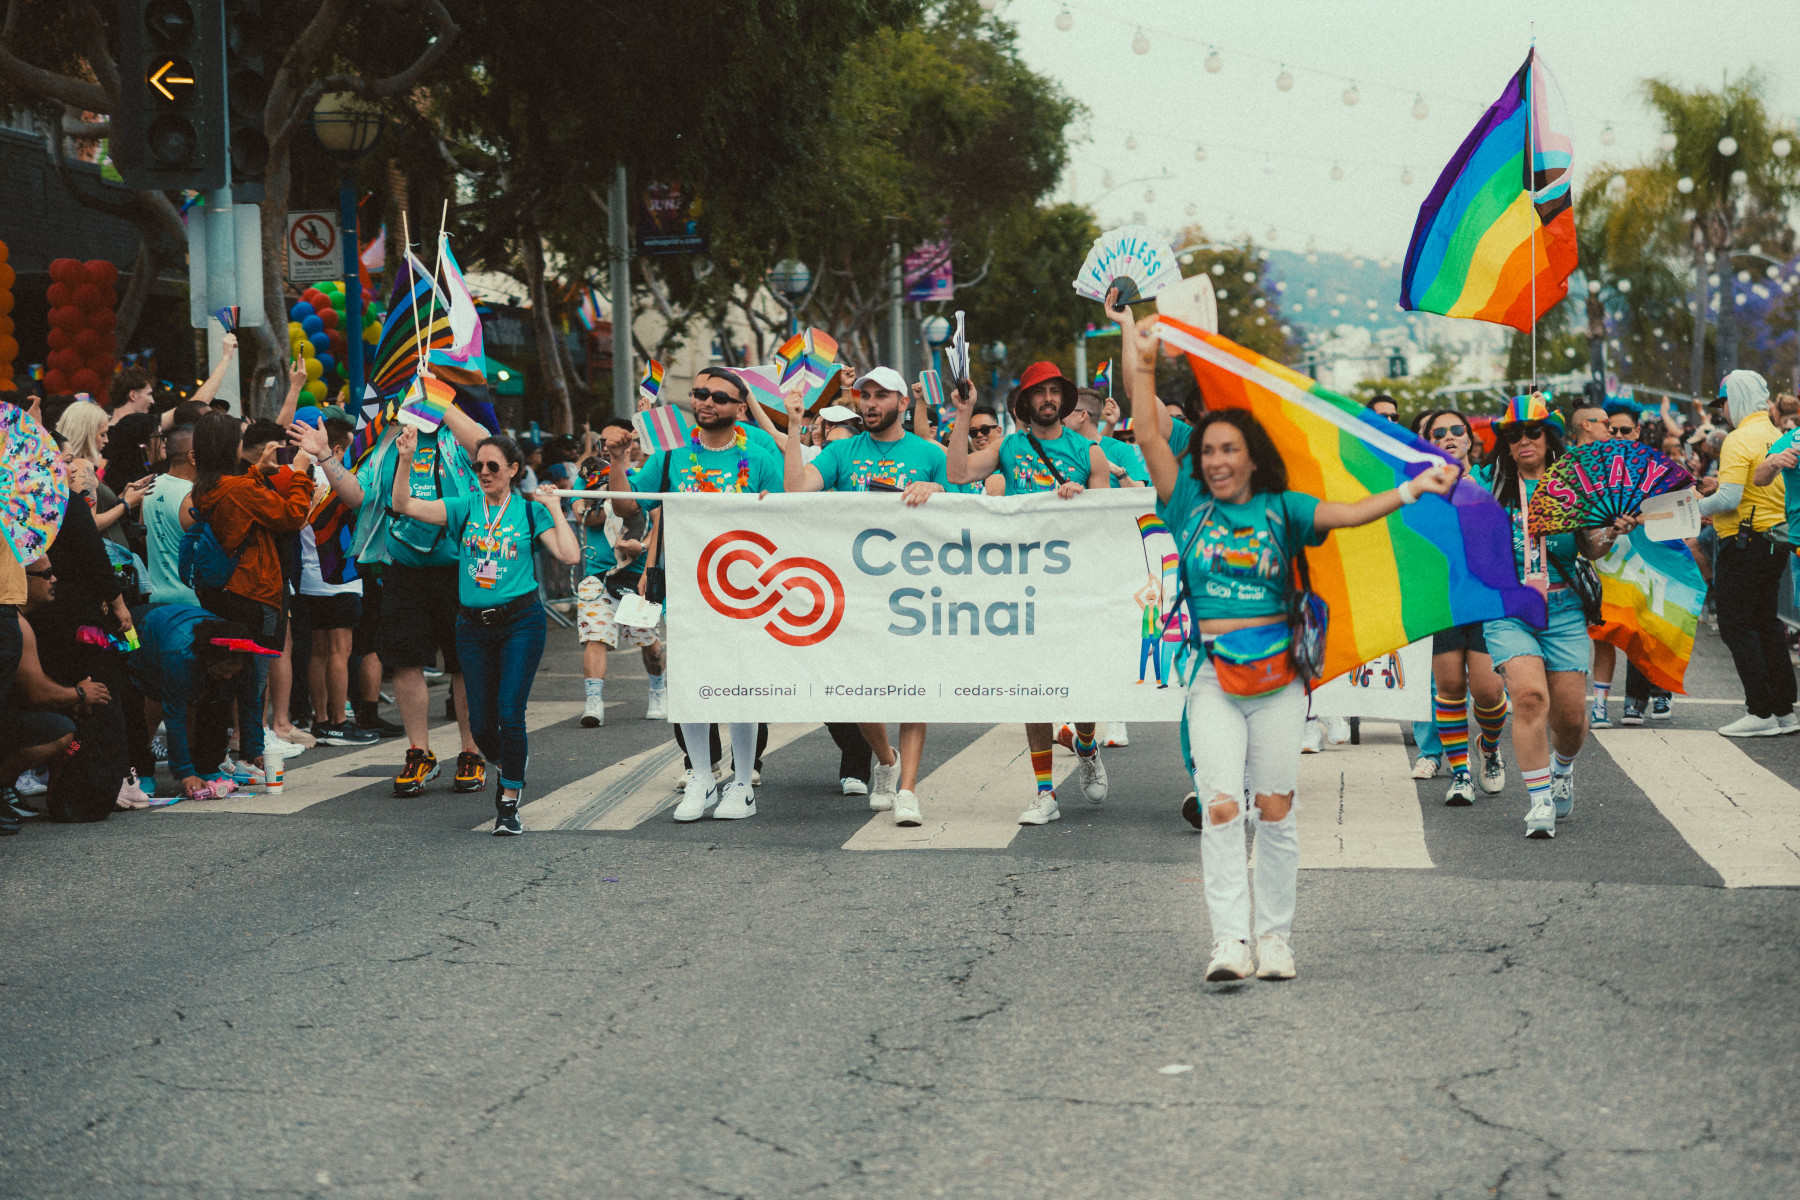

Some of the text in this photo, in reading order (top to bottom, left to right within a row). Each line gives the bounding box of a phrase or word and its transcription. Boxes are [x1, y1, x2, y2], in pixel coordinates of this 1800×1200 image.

[1091, 237, 1161, 282] FLAWLESS
[1546, 454, 1668, 510] SLAY
[852, 527, 1072, 577] Cedars
[887, 585, 1037, 637] Sinai
[698, 683, 1070, 700] @cedarssinai #CedarsPride cedars-sinai.org
